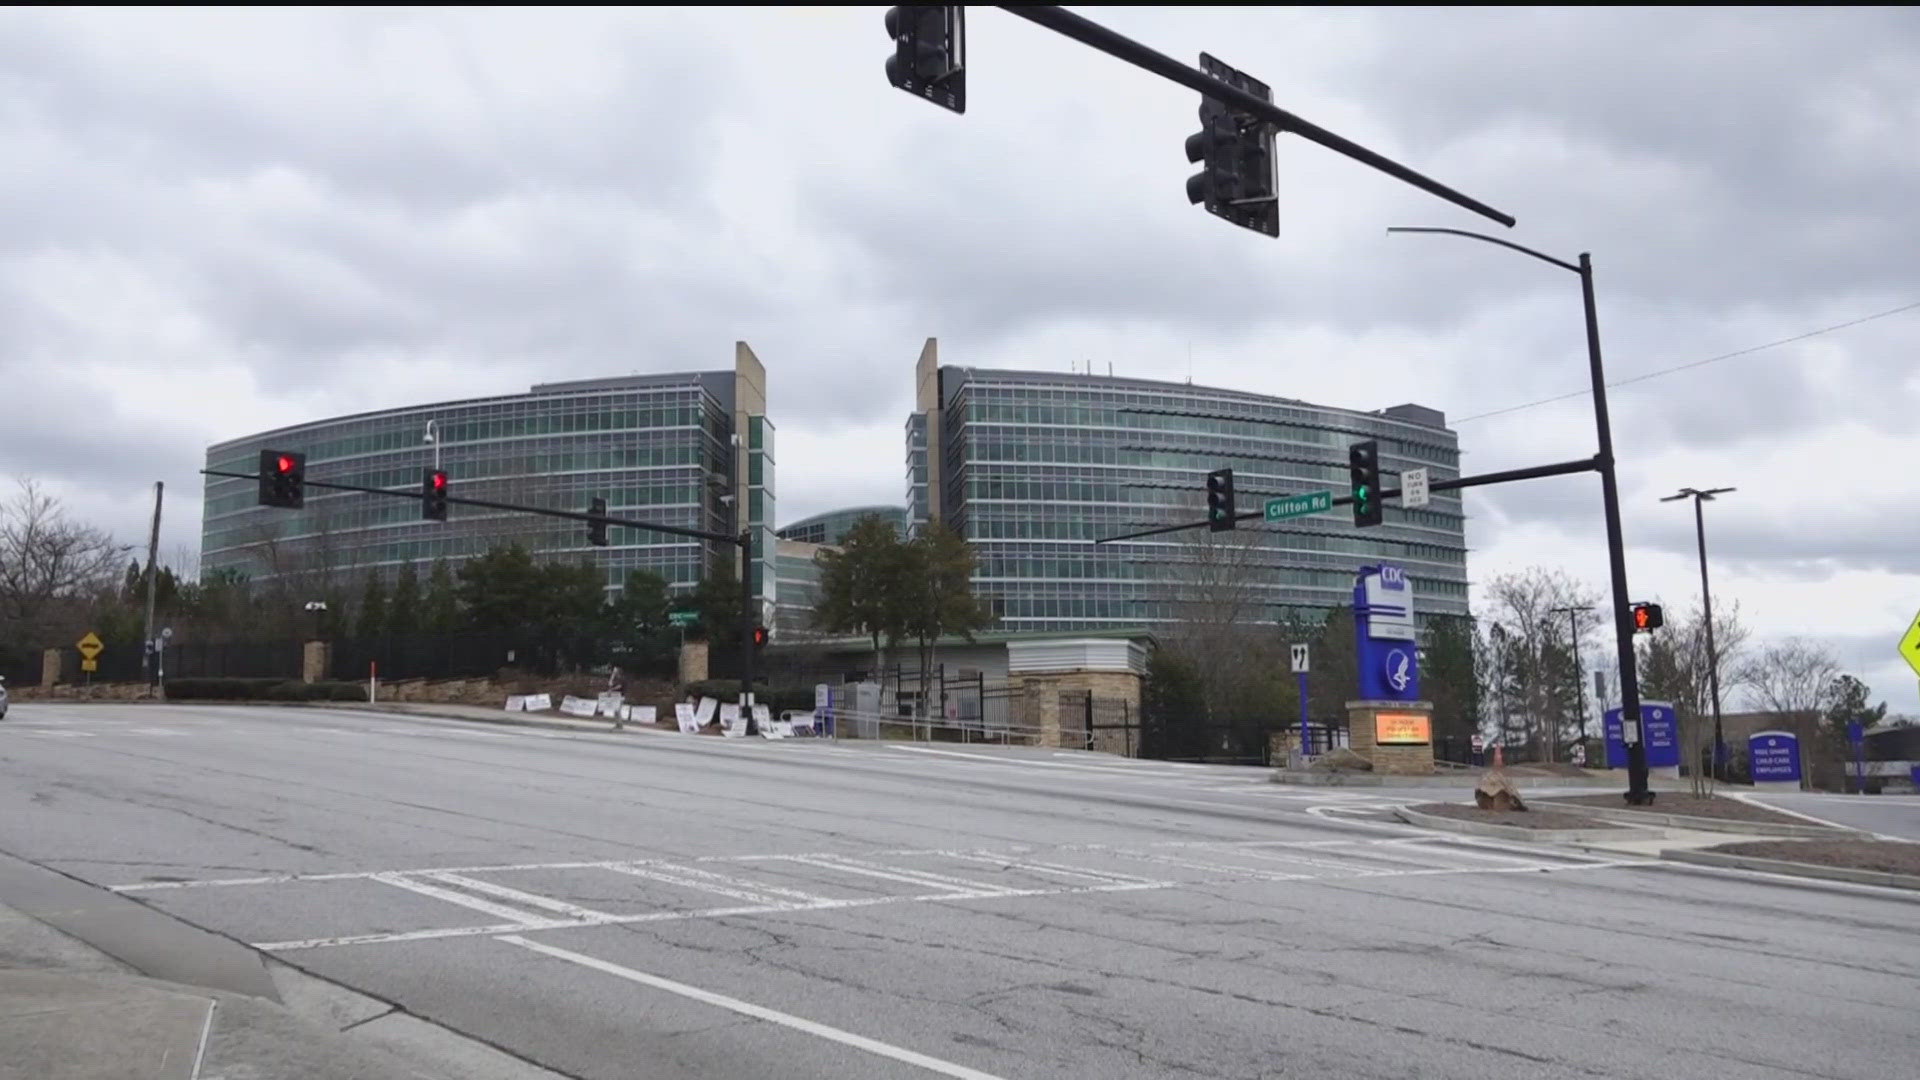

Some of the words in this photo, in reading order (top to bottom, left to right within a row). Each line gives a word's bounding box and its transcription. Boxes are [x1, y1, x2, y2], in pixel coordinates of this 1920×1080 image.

[1407, 472, 1422, 481] NO
[1269, 500, 1309, 517] Clifton
[1312, 496, 1327, 510] Rd
[1381, 566, 1405, 583] CDC
